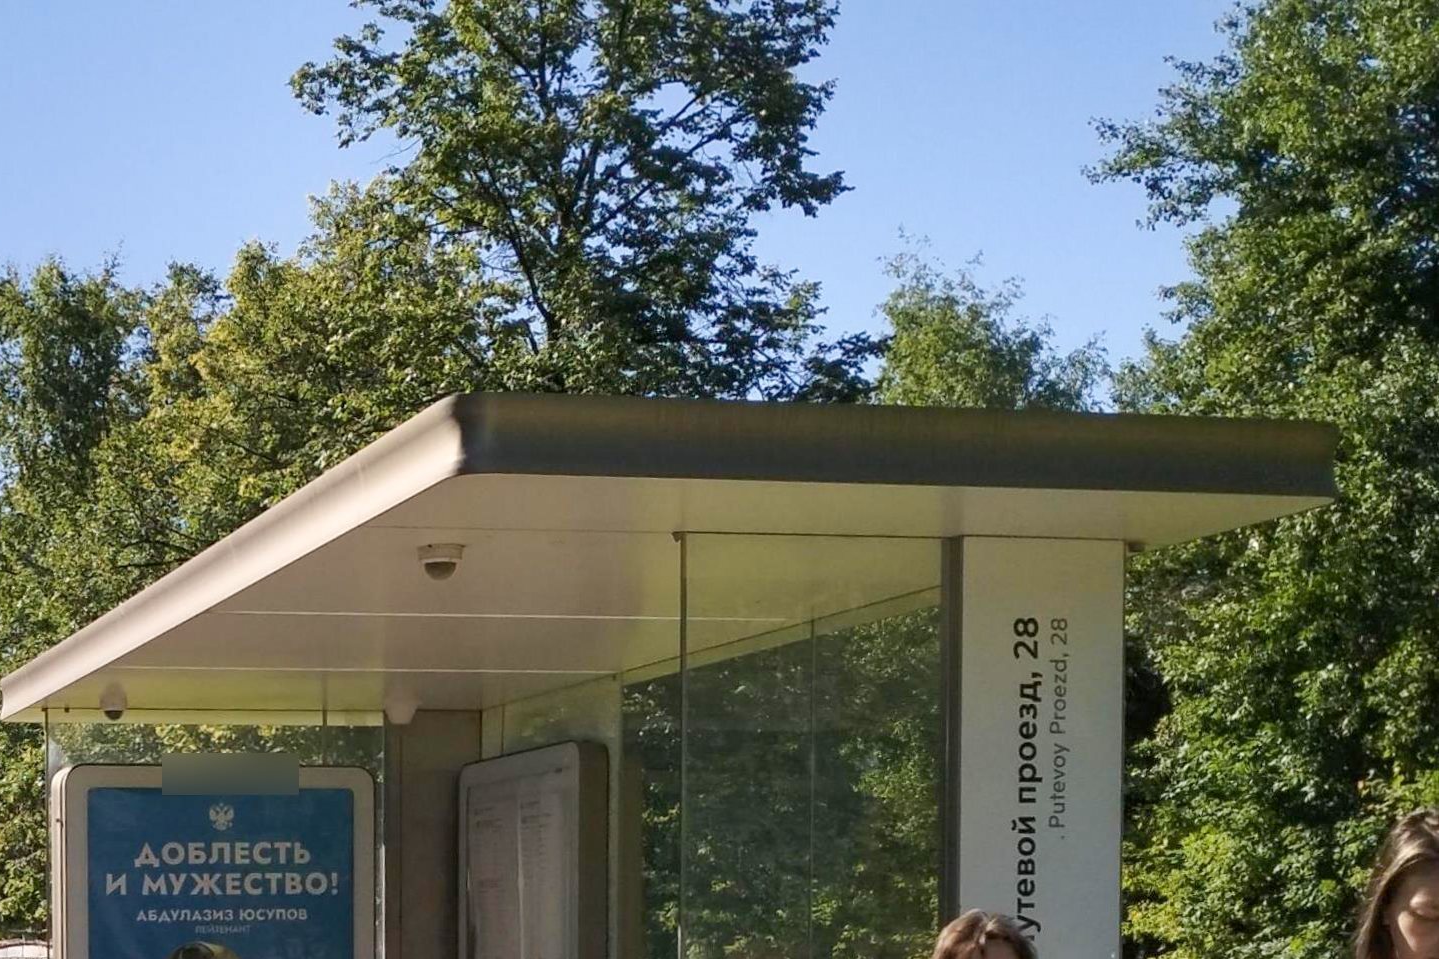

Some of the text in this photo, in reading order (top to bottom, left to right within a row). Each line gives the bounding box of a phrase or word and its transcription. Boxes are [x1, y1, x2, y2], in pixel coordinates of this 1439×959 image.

[1012, 616, 1040, 661] 28
[1016, 669, 1044, 806] проезд,
[1048, 616, 1071, 830] Putevoy Proezd, 28
[133, 841, 311, 868] ДОБЛЕСТЬ
[105, 871, 340, 896] И МУЖЕСТВО!
[136, 908, 308, 923] АБДУЛАЗИЗ ЮСУПОВ
